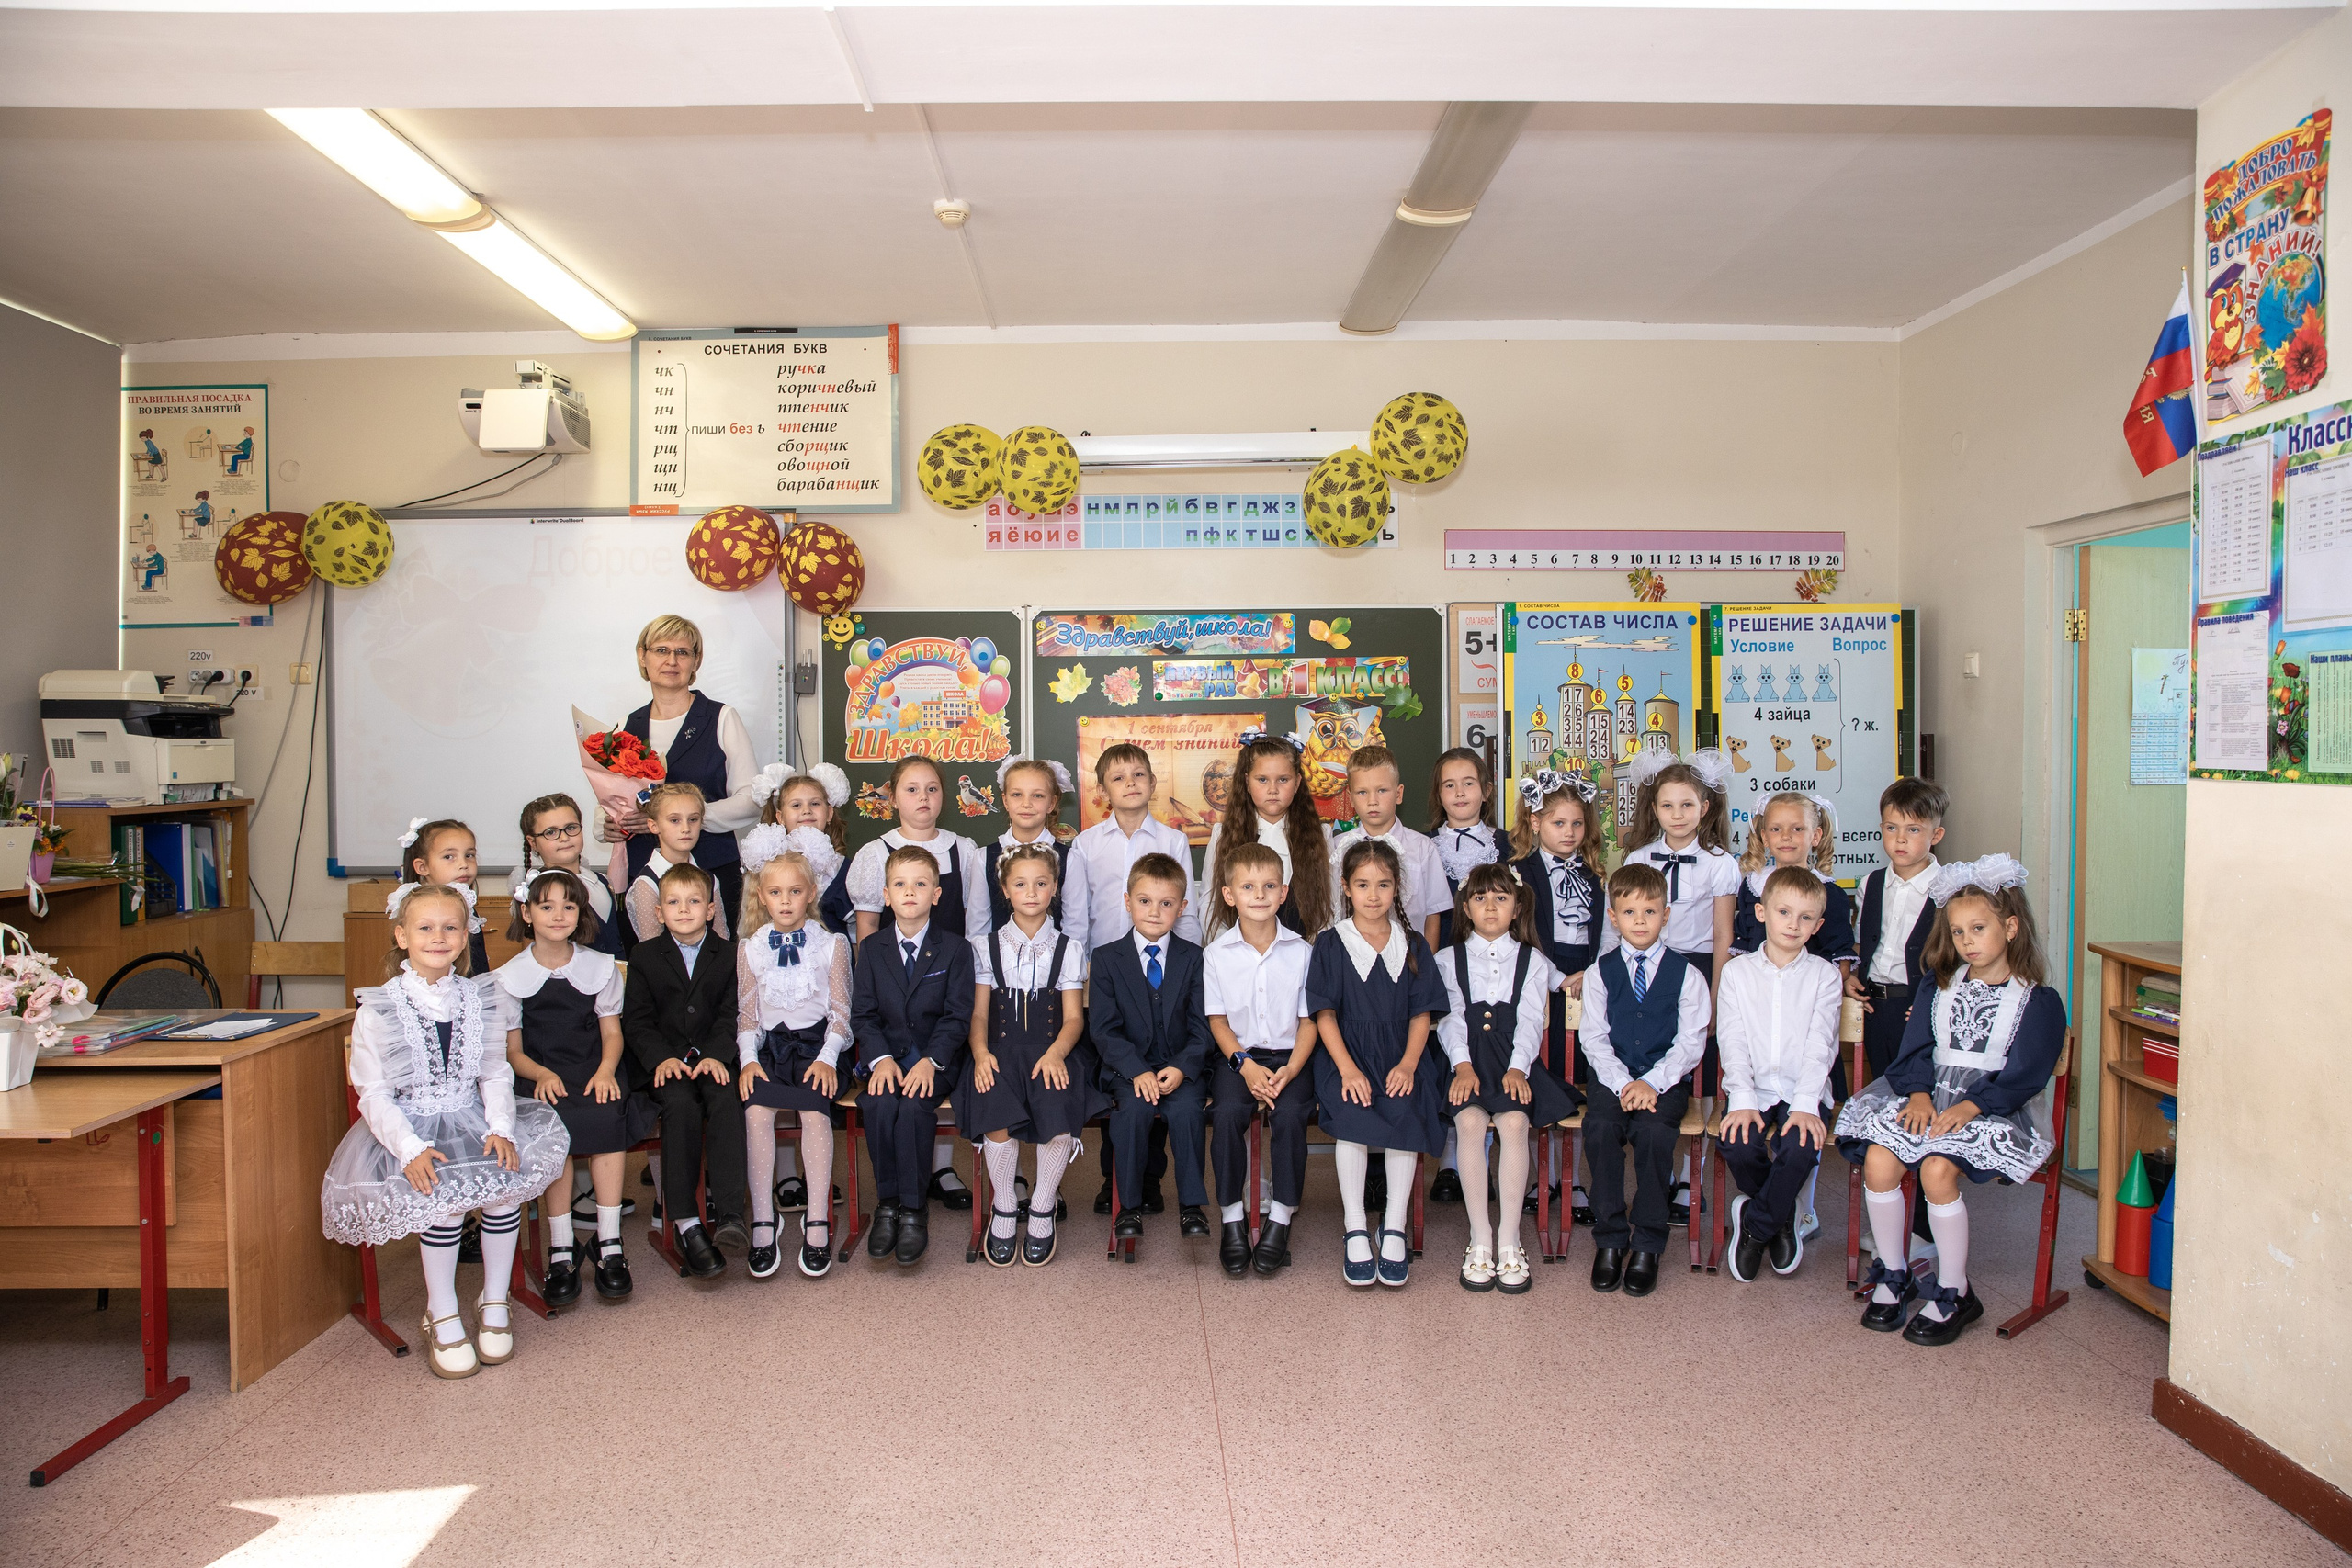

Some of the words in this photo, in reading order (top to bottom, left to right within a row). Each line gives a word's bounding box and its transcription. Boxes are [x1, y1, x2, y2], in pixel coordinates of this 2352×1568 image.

[2238, 138, 2293, 182] ДОБРО
[2213, 151, 2317, 222] ПОЖАЛОВАТЬ
[2209, 248, 2219, 268] В
[2224, 208, 2290, 261] СТРАНУ
[2244, 227, 2323, 323] ЗНАНИЙ!
[704, 344, 785, 355] СОЧЕТАНИЯ
[793, 343, 828, 355] БУКВ
[654, 365, 674, 377] чк
[776, 363, 826, 379] ручка
[654, 385, 674, 396] чн
[776, 380, 877, 398] коричневый
[128, 395, 200, 404] ПРАВИЛЬНАЯ
[201, 394, 252, 403] ПОСАДКА
[154, 406, 189, 414] ВРЕМЯ
[191, 404, 241, 413] ЗАНЯТИЙ
[654, 405, 674, 416] нч
[777, 401, 850, 414] птенчик
[654, 424, 678, 435] чт
[691, 424, 726, 435] пиши
[729, 423, 753, 435] без
[757, 423, 766, 435] ь
[777, 421, 838, 433] чтение
[653, 445, 678, 458] рщ
[777, 440, 849, 454] сборщик
[2198, 445, 2237, 462] Поздравляем
[653, 463, 678, 476] щн
[777, 458, 850, 473] овощной
[2285, 468, 2299, 478] Наш
[2300, 463, 2319, 474] класс
[653, 482, 678, 495] нщ
[776, 477, 880, 495] барабанщик
[527, 535, 672, 589] Доброе
[1451, 554, 1456, 564] 1
[1469, 554, 1476, 564] 2
[1490, 554, 1497, 564] 3
[1510, 554, 1517, 564] 4
[1531, 554, 1538, 564] 5
[1550, 554, 1558, 564] 6
[1572, 554, 1579, 564] 7
[1591, 554, 1598, 565] 8
[1611, 554, 1618, 565] 9
[1630, 555, 1642, 565] 10
[1650, 555, 1662, 565] 11
[1669, 555, 1681, 565] 12
[1690, 555, 1702, 565] 13
[1709, 555, 1721, 565] 14
[1730, 555, 1742, 565] 15
[1750, 555, 1762, 565] 16
[1770, 555, 1781, 565] 17
[1788, 555, 1800, 565] 18
[1808, 555, 1820, 565] 19
[1826, 555, 1839, 565] 20
[1466, 617, 1494, 625] СЛАГАЕМОЕ
[1527, 615, 1606, 629] СОСТАВ
[1614, 615, 1678, 629] ЧИСЛА
[1729, 618, 1813, 632] РЕШЕНИЕ
[1820, 617, 1887, 633] ЗАДАЧИ
[2198, 617, 2221, 627] Правила
[2222, 613, 2254, 624] поведения
[1730, 639, 1795, 653] Условие
[1832, 637, 1887, 654] Вопрос
[2310, 654, 2329, 664] Наши
[1165, 662, 1234, 681] ПЕРВЫЙ
[1571, 665, 1579, 679] 8
[849, 643, 968, 716] ЗДРАВСТВУЙ,
[1267, 667, 1284, 696] В
[1291, 662, 1309, 696] 1
[1316, 666, 1404, 696] КЛАСС!
[1622, 676, 1629, 690] 5
[1204, 682, 1236, 698] РАЗ
[1594, 690, 1602, 704] 6
[1536, 712, 1543, 726] 3
[1651, 714, 1659, 728] 4
[1754, 708, 1763, 721] 4
[1768, 706, 1811, 722] зайца
[1128, 722, 1135, 734] 1
[1141, 720, 1212, 736] сентября
[1852, 717, 1860, 731] ?
[1864, 719, 1879, 731] ж.
[1174, 733, 1242, 750] знаний
[1467, 724, 1485, 748] 6
[848, 728, 993, 762] Школа!
[1629, 739, 1637, 753] 7
[1750, 778, 1758, 791] 3
[1764, 777, 1816, 791] собаки
[1732, 831, 1740, 844] 4
[1842, 831, 1882, 842] всего
